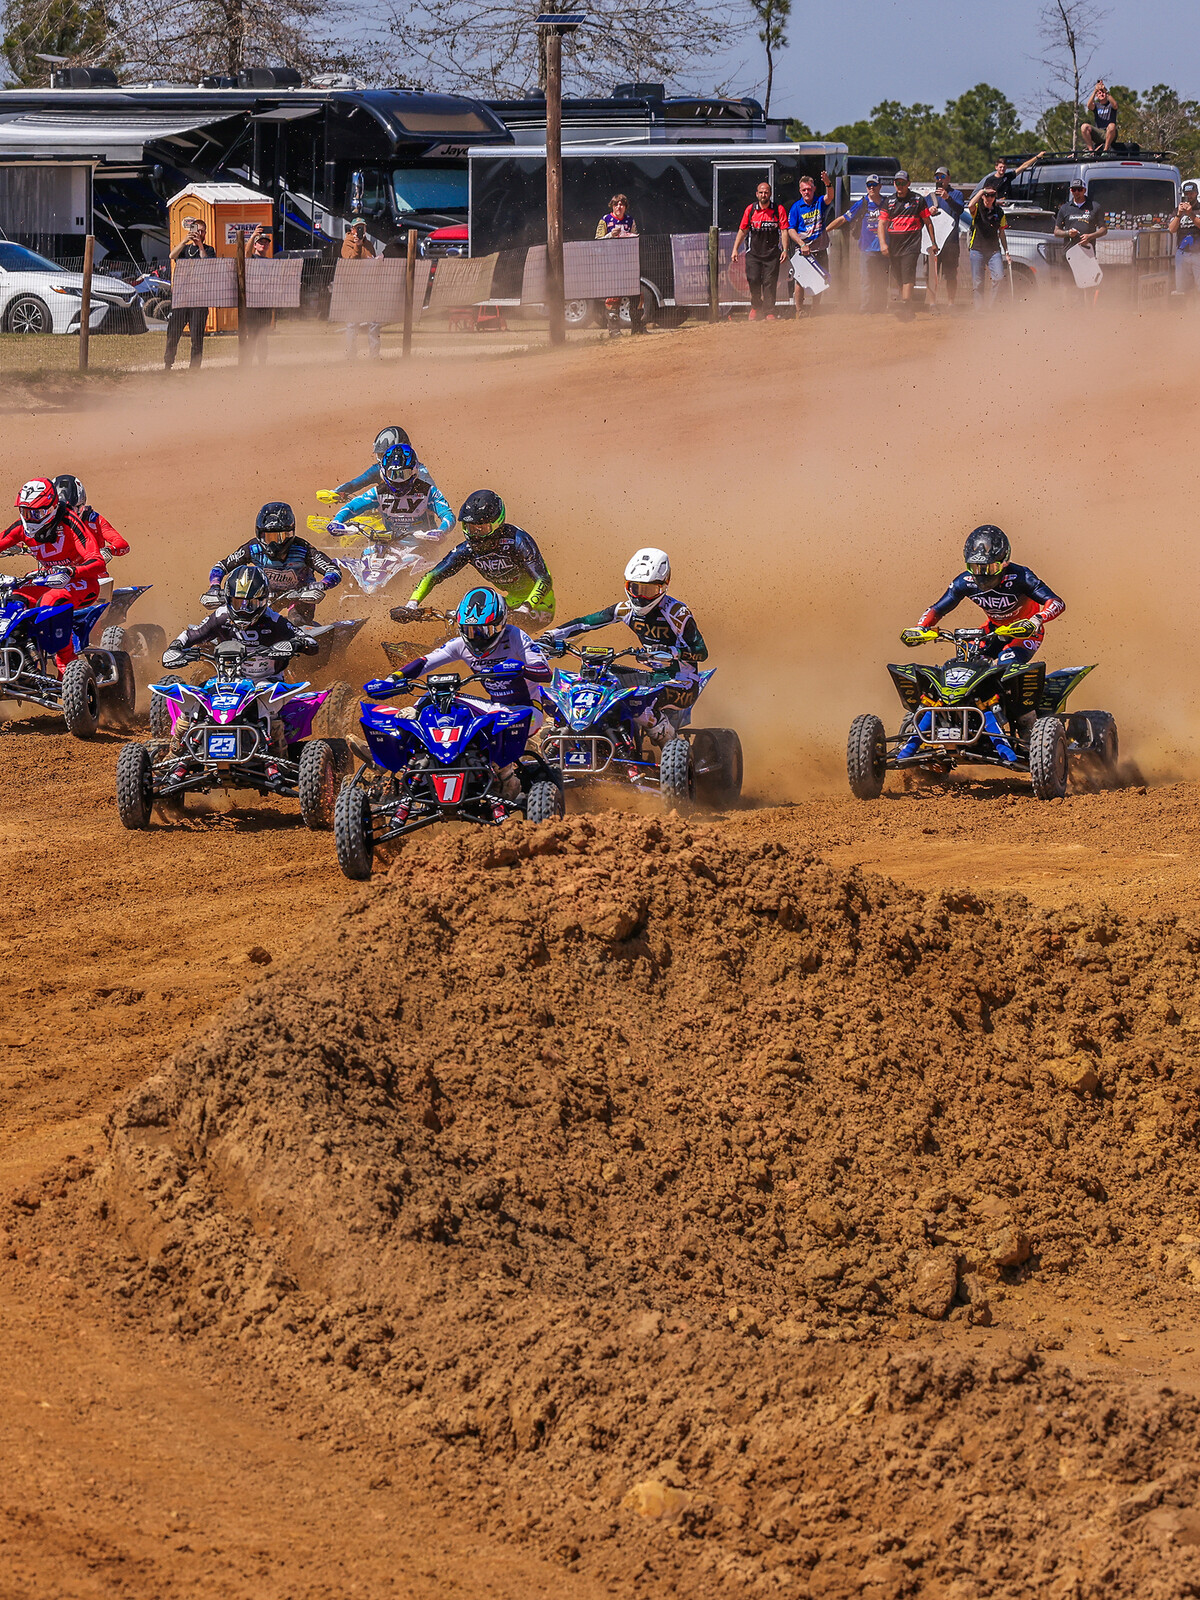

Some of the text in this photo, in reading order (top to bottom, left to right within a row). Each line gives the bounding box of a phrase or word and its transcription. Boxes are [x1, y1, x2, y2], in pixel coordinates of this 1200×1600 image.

[441, 145, 469, 156] Jayc
[382, 498, 423, 514] FLY
[31, 535, 67, 559] FLY
[475, 559, 514, 571] ONEAL
[366, 571, 380, 580] 2
[972, 596, 1016, 609] ONEAL
[634, 621, 669, 639] FXR
[212, 696, 240, 707] 23
[574, 692, 596, 704] 4
[441, 728, 452, 742] 1
[938, 727, 961, 740] 26
[209, 737, 236, 753] 23
[569, 754, 586, 764] 4
[442, 777, 457, 801] 1
